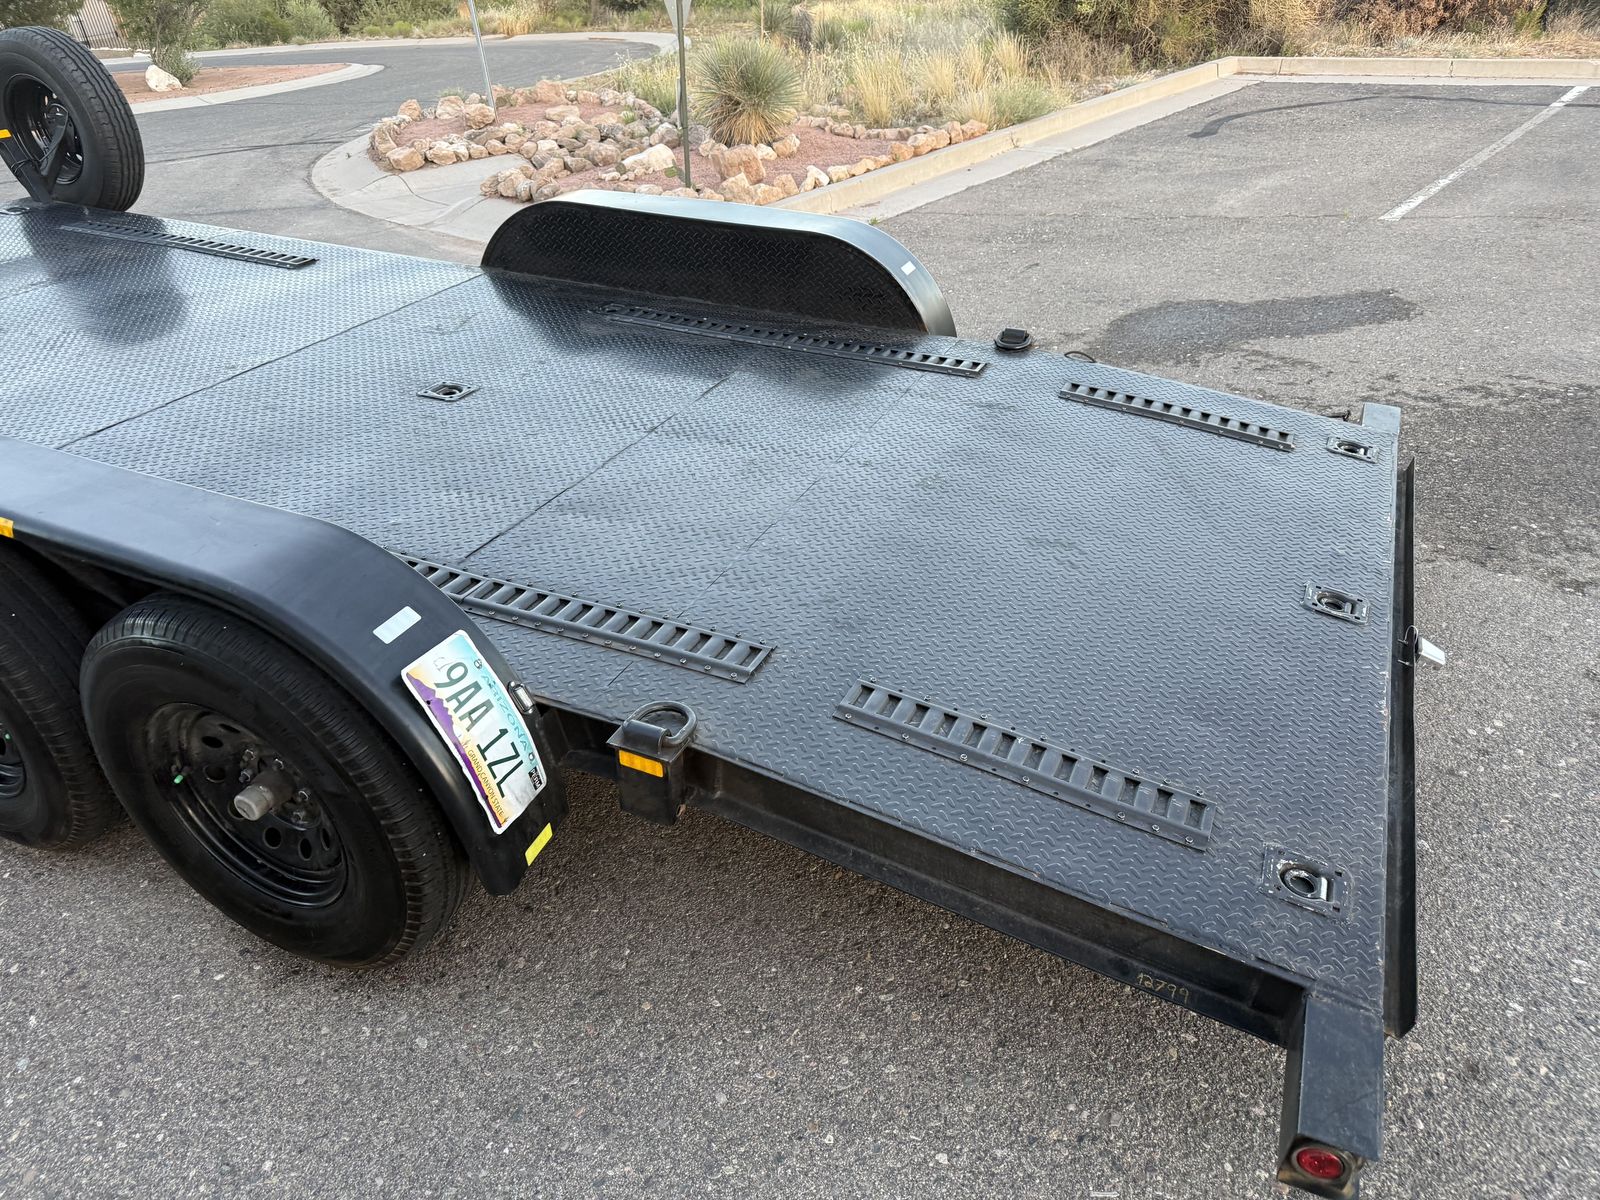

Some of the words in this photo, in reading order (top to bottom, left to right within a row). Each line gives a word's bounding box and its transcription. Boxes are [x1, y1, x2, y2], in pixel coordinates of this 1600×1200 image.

[434, 661, 494, 732] 9AA
[476, 728, 524, 798] 1ZL
[481, 675, 528, 751] ARIZONA
[467, 749, 483, 774] GRAND
[479, 772, 496, 799] CANYON
[491, 798, 505, 816] STATE
[530, 768, 541, 788] PERM
